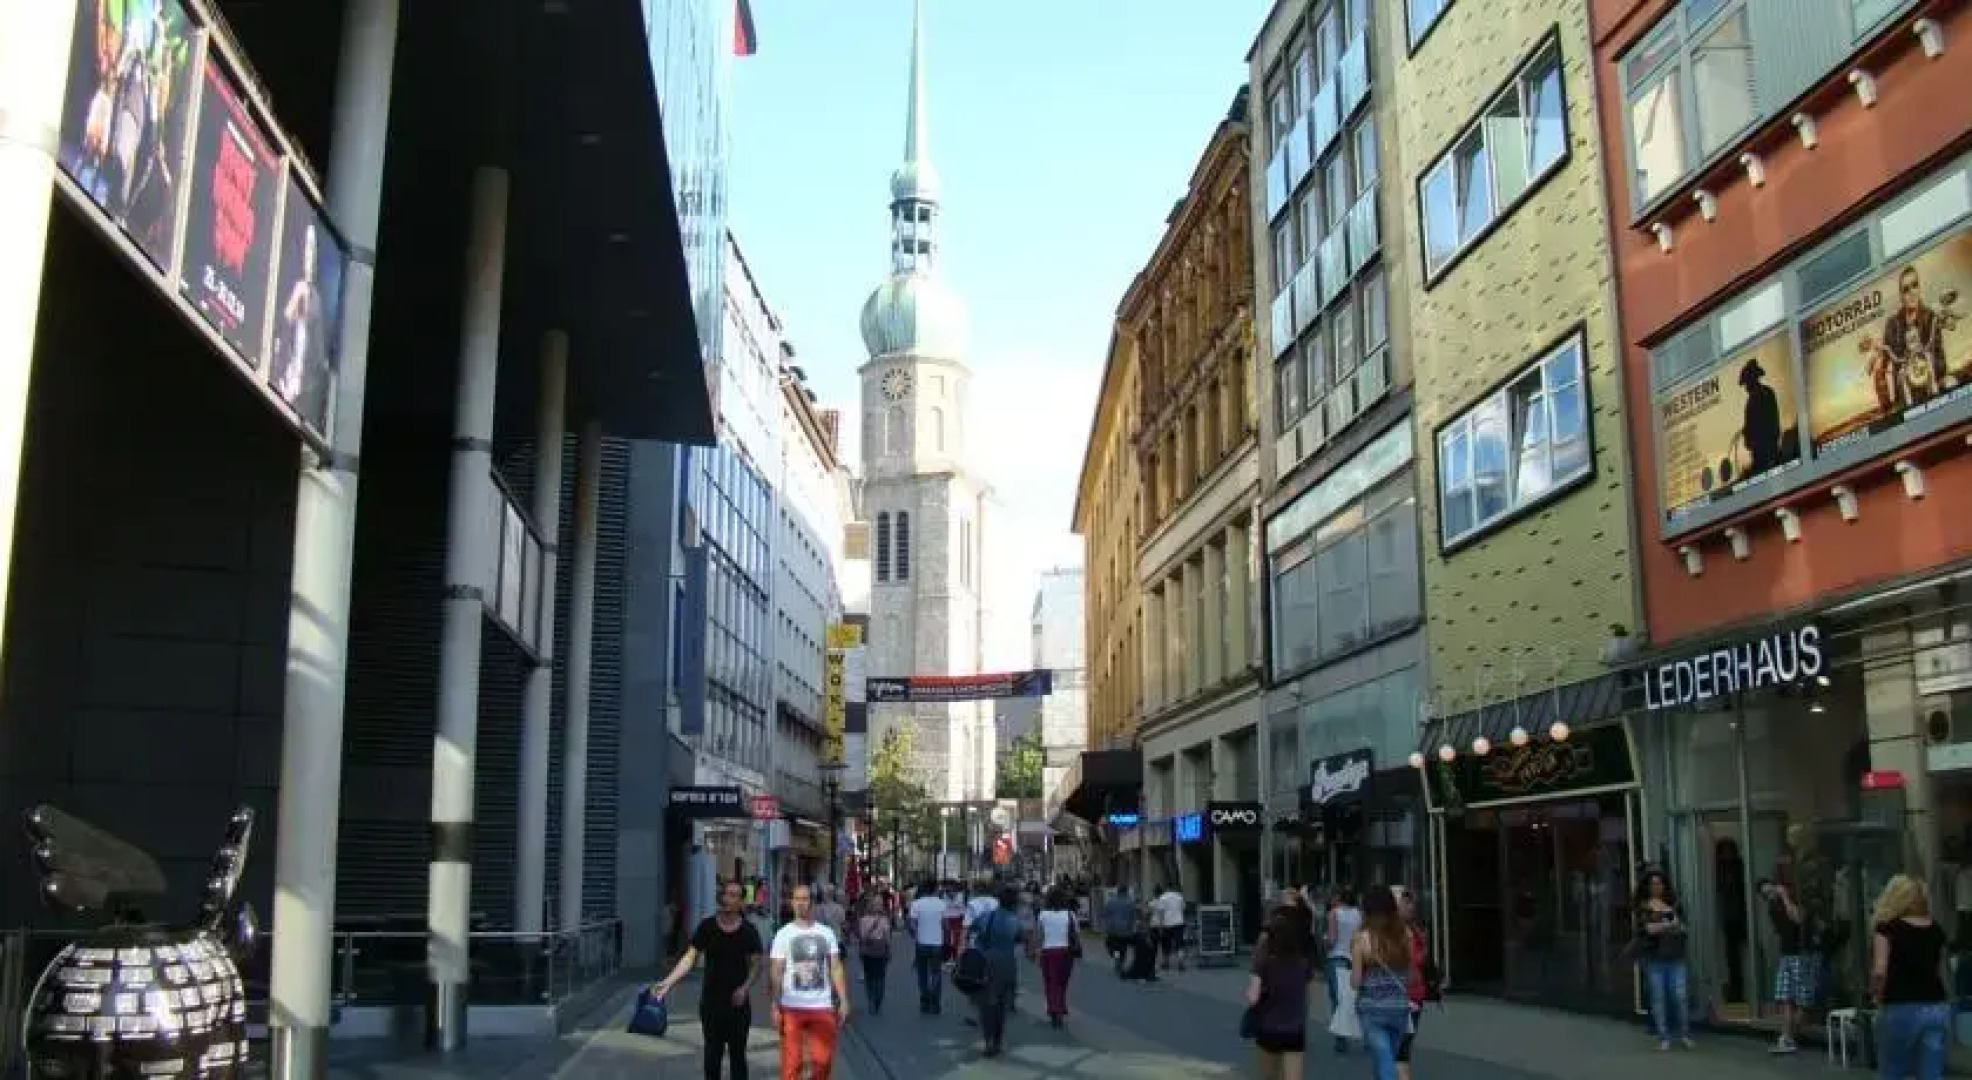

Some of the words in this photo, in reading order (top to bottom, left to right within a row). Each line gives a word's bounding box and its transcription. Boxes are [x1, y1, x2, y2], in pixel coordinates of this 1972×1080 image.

[1662, 376, 1719, 417] WESTERN
[1644, 626, 1821, 710] LEDERHAUS
[1211, 809, 1257, 825] CAMO
